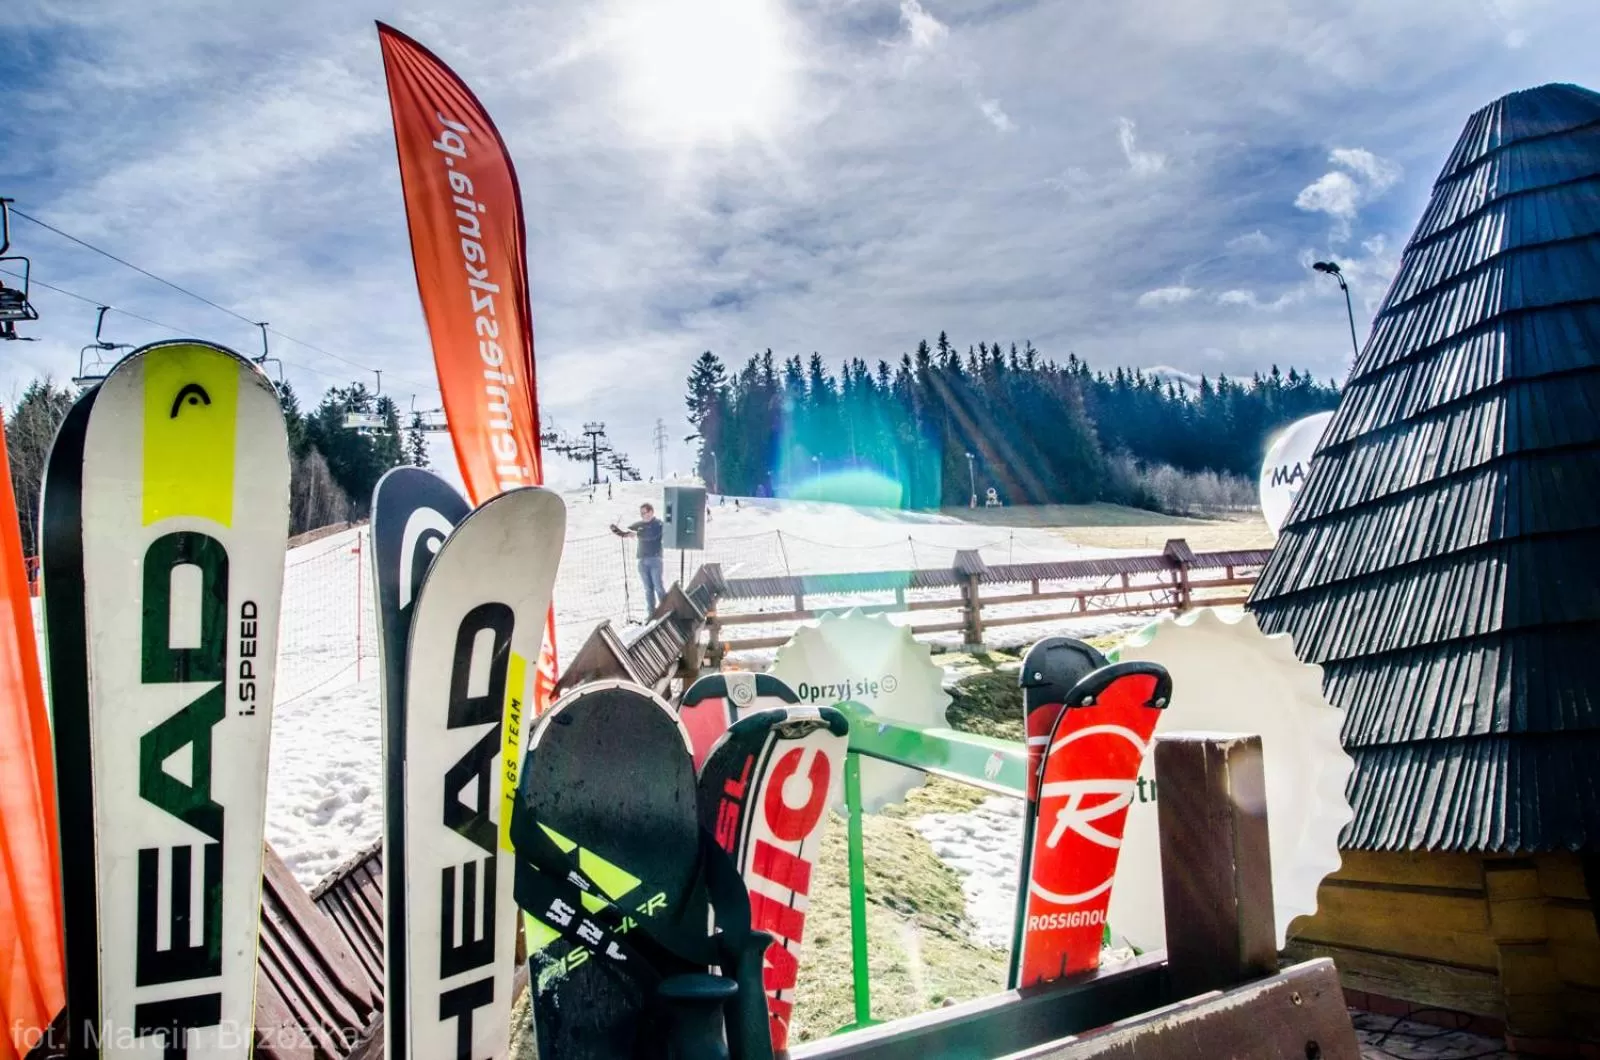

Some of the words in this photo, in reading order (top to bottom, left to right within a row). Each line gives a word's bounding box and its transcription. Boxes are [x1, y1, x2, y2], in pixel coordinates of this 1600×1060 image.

[1271, 461, 1312, 488] MA
[238, 600, 259, 717] i.SPEED
[798, 678, 851, 703] Oprzyj
[856, 677, 879, 698] się
[508, 697, 521, 747] TEAM
[439, 602, 515, 1060] HEAD
[715, 754, 754, 853] SL
